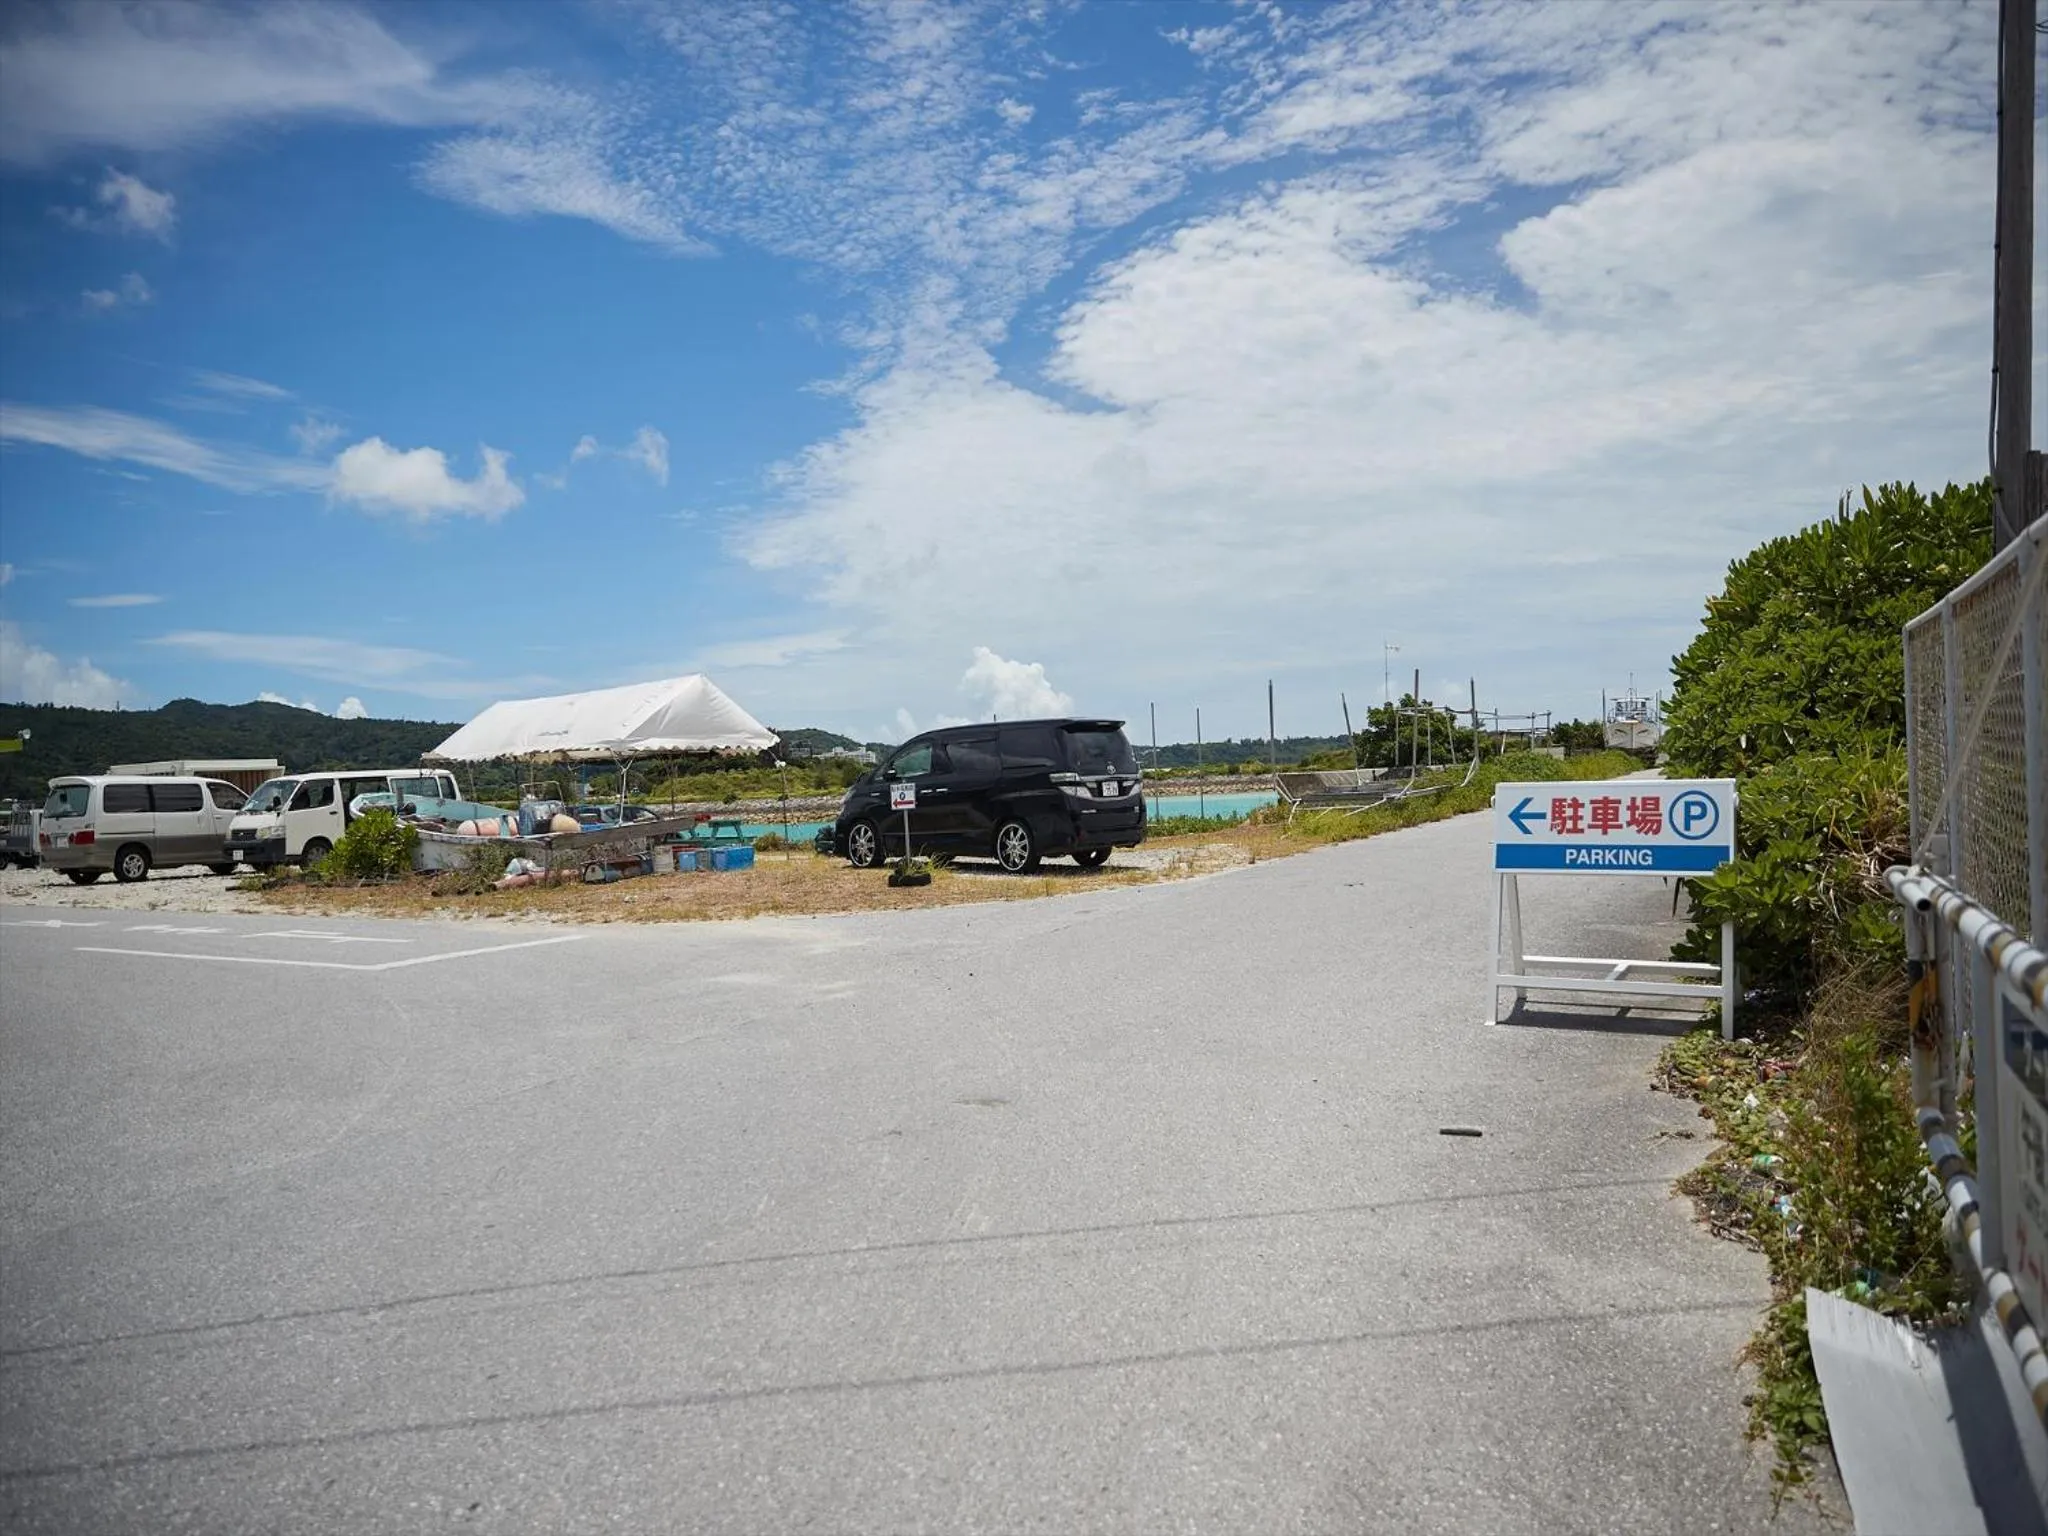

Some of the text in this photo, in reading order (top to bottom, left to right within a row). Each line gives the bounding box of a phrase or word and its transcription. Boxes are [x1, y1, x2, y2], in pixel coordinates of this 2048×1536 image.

[1550, 796, 1663, 836] 駐車場
[1565, 848, 1653, 866] PARKING
